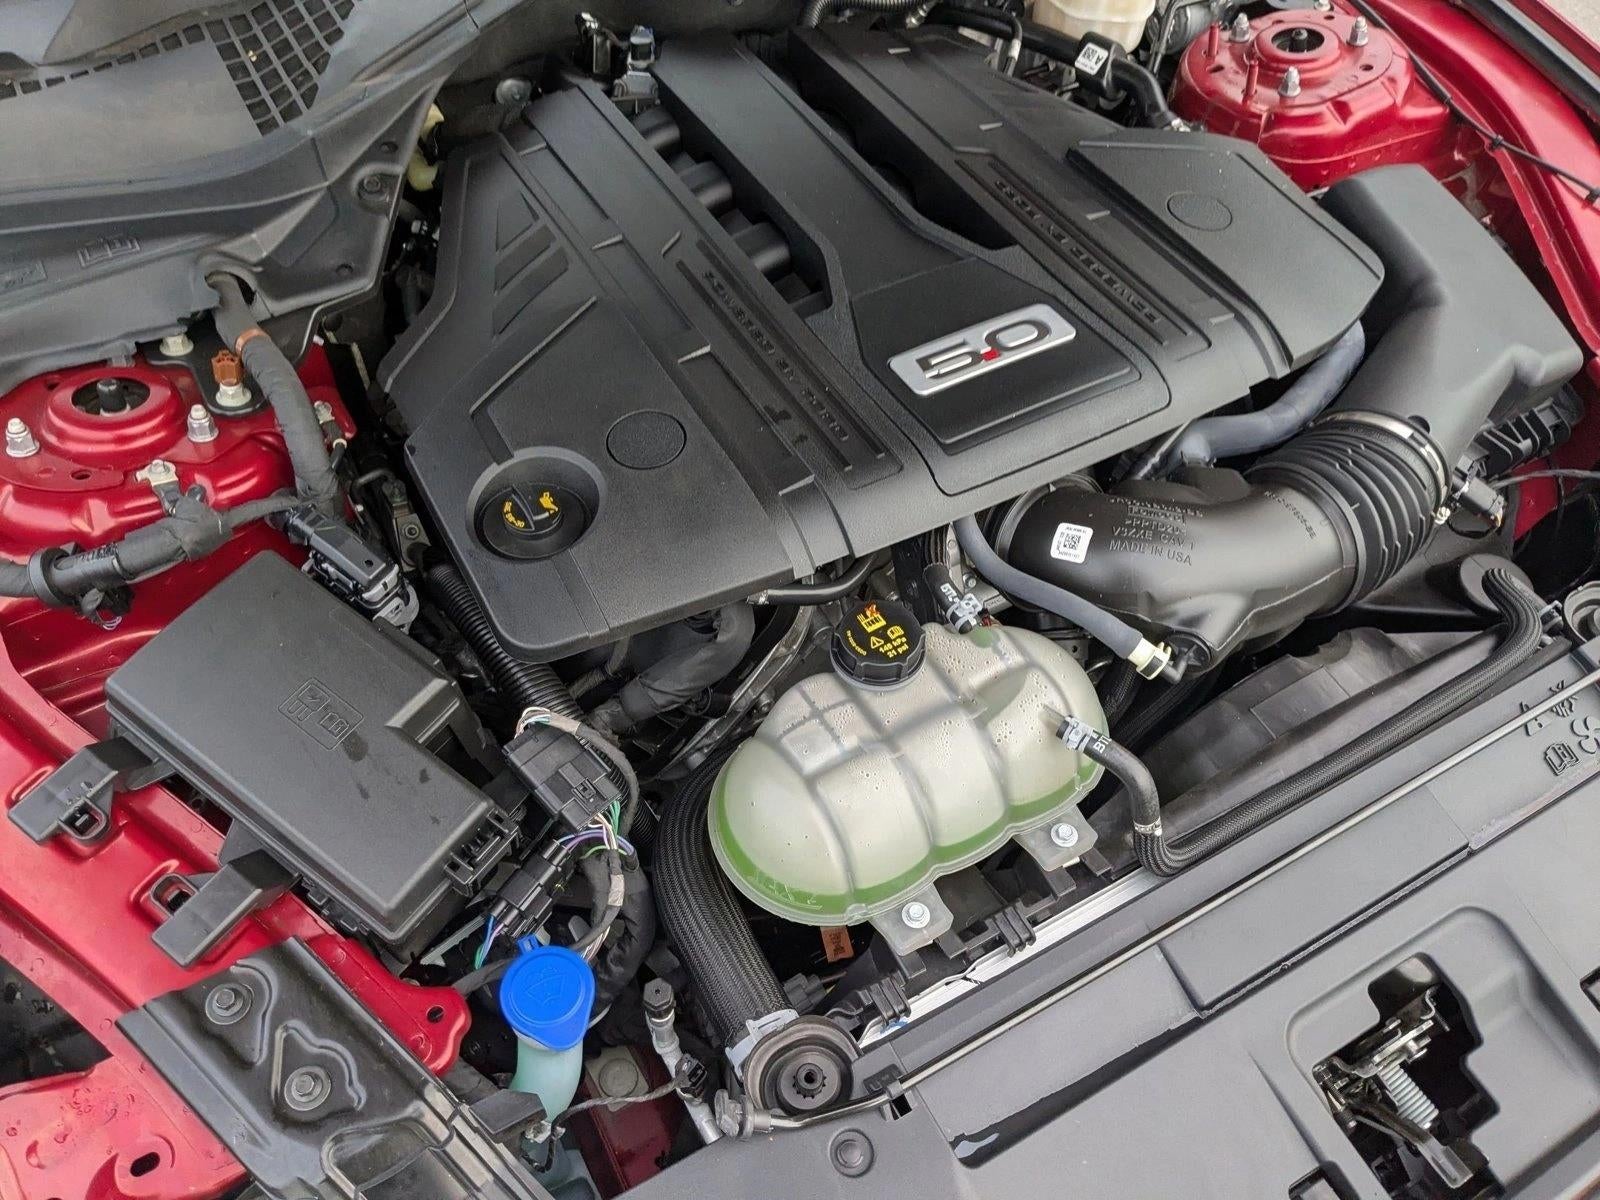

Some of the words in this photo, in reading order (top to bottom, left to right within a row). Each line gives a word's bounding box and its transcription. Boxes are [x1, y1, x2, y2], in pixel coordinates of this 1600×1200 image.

[915, 319, 1052, 380] 5.0
[1151, 545, 1164, 557] IN
[1167, 548, 1192, 567] USA
